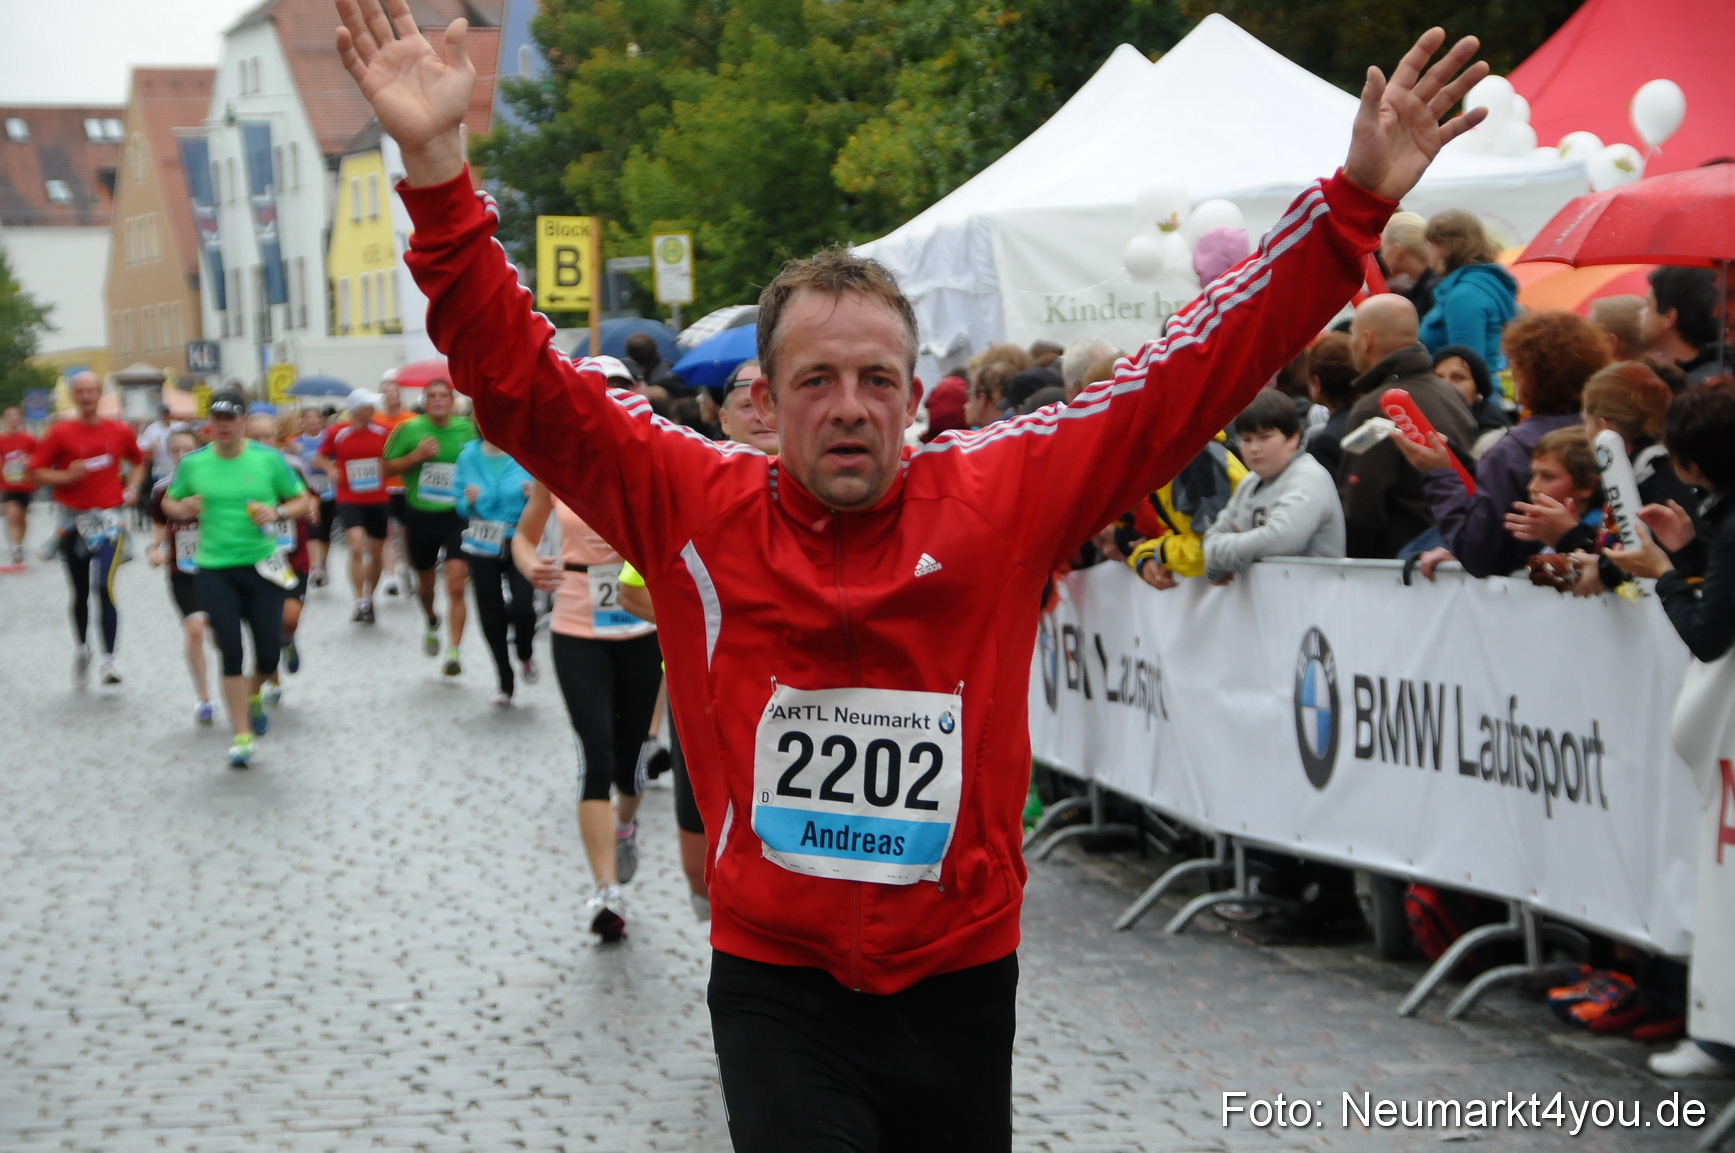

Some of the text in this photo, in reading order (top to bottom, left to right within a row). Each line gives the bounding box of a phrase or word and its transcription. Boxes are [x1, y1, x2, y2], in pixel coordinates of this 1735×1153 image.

[544, 220, 590, 237] Block
[553, 246, 582, 287] B
[1044, 293, 1146, 323] Kinder
[1606, 486, 1636, 546] BMW
[914, 562, 942, 577] adidas
[834, 706, 930, 730] Neumarkt
[1354, 674, 1608, 819] BMW Laufsport
[776, 730, 944, 811] 2202
[762, 791, 770, 803] D
[800, 821, 905, 856] Andreas
